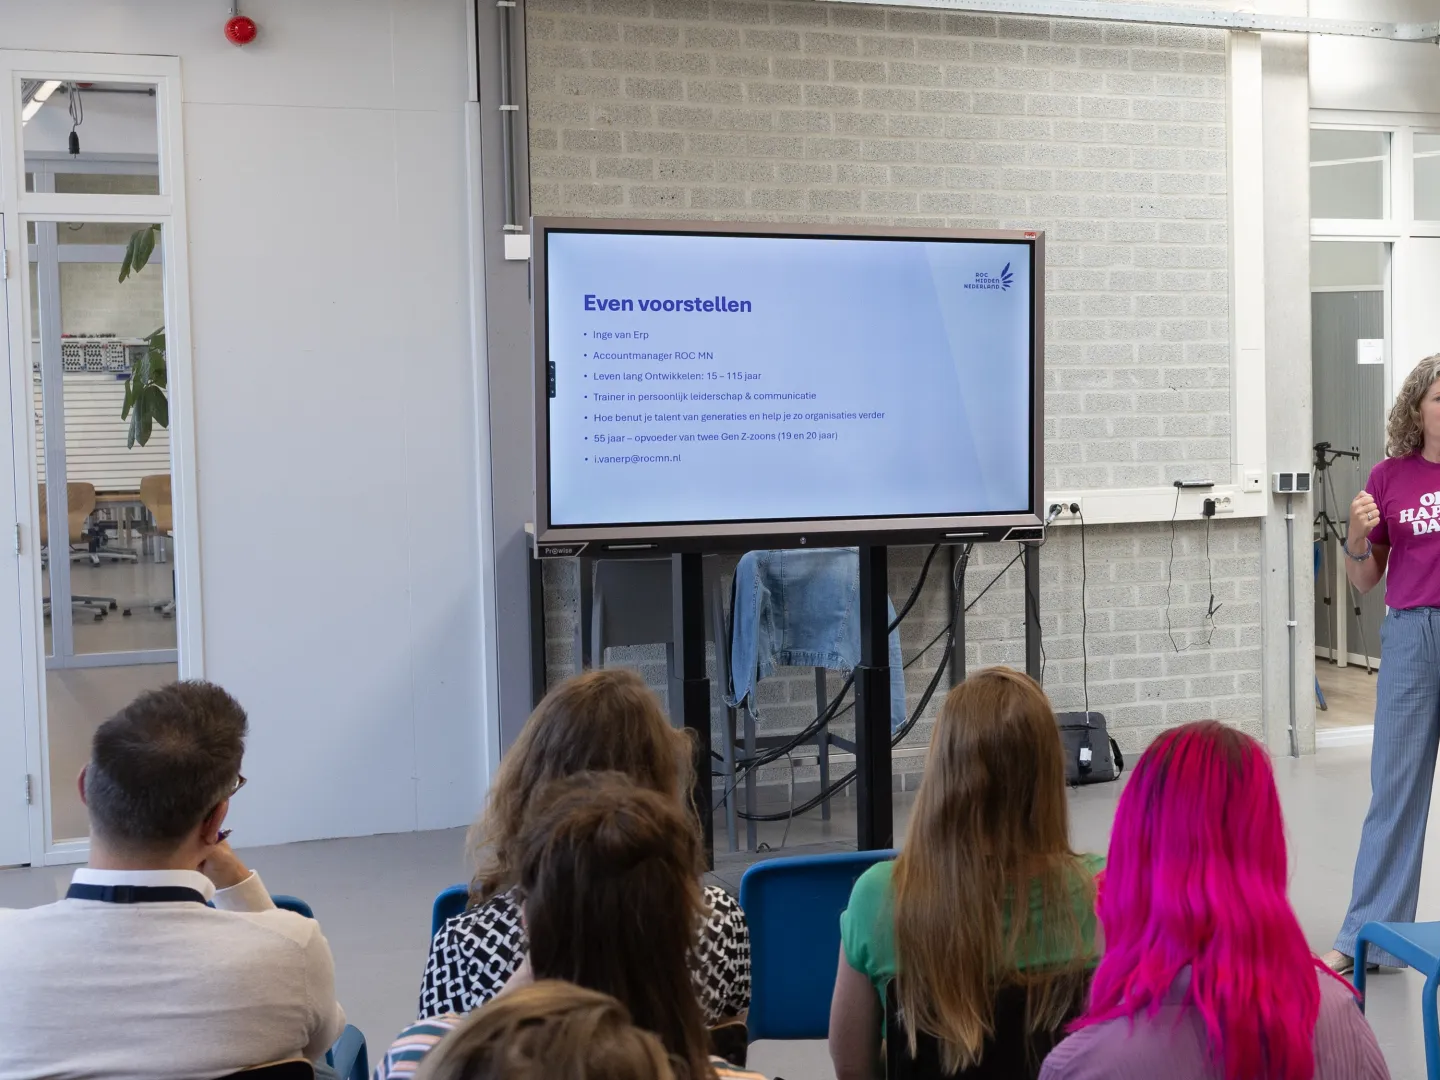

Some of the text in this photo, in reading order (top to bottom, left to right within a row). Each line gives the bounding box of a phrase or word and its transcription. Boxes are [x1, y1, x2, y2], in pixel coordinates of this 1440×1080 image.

[584, 294, 752, 313] Even voorstellen
[593, 330, 613, 341] Inge
[633, 330, 650, 341] Erp
[592, 351, 714, 362] Accountmanager ROC MN
[593, 372, 621, 381] Leven
[623, 372, 644, 383] lang
[644, 371, 704, 381] Ontwikkelen:
[706, 371, 718, 381] 15
[726, 371, 743, 380] 115
[743, 371, 762, 382] jaar
[593, 391, 817, 403] Trainer in persoonlijk leiderschap & communicatie
[593, 413, 614, 423] Hoe
[615, 413, 643, 422] benut
[643, 412, 653, 424] je
[654, 413, 682, 422] talent
[682, 414, 699, 422] van
[700, 411, 748, 423] generaties
[748, 413, 761, 421] en
[762, 411, 782, 423] help
[782, 411, 792, 422] je
[804, 411, 857, 422] organisaties
[858, 411, 886, 420] verder
[593, 434, 606, 443] 55
[606, 433, 626, 445] jaar
[634, 433, 678, 444] opvoeder
[678, 434, 696, 442] van
[696, 433, 719, 442] twee
[720, 432, 740, 441] Gen
[740, 432, 776, 441] Z-zoons
[777, 432, 792, 442] (19
[806, 431, 818, 440] 20
[818, 431, 838, 442] jaar)
[593, 453, 682, 465] i.vanerp@rocmn.nl
